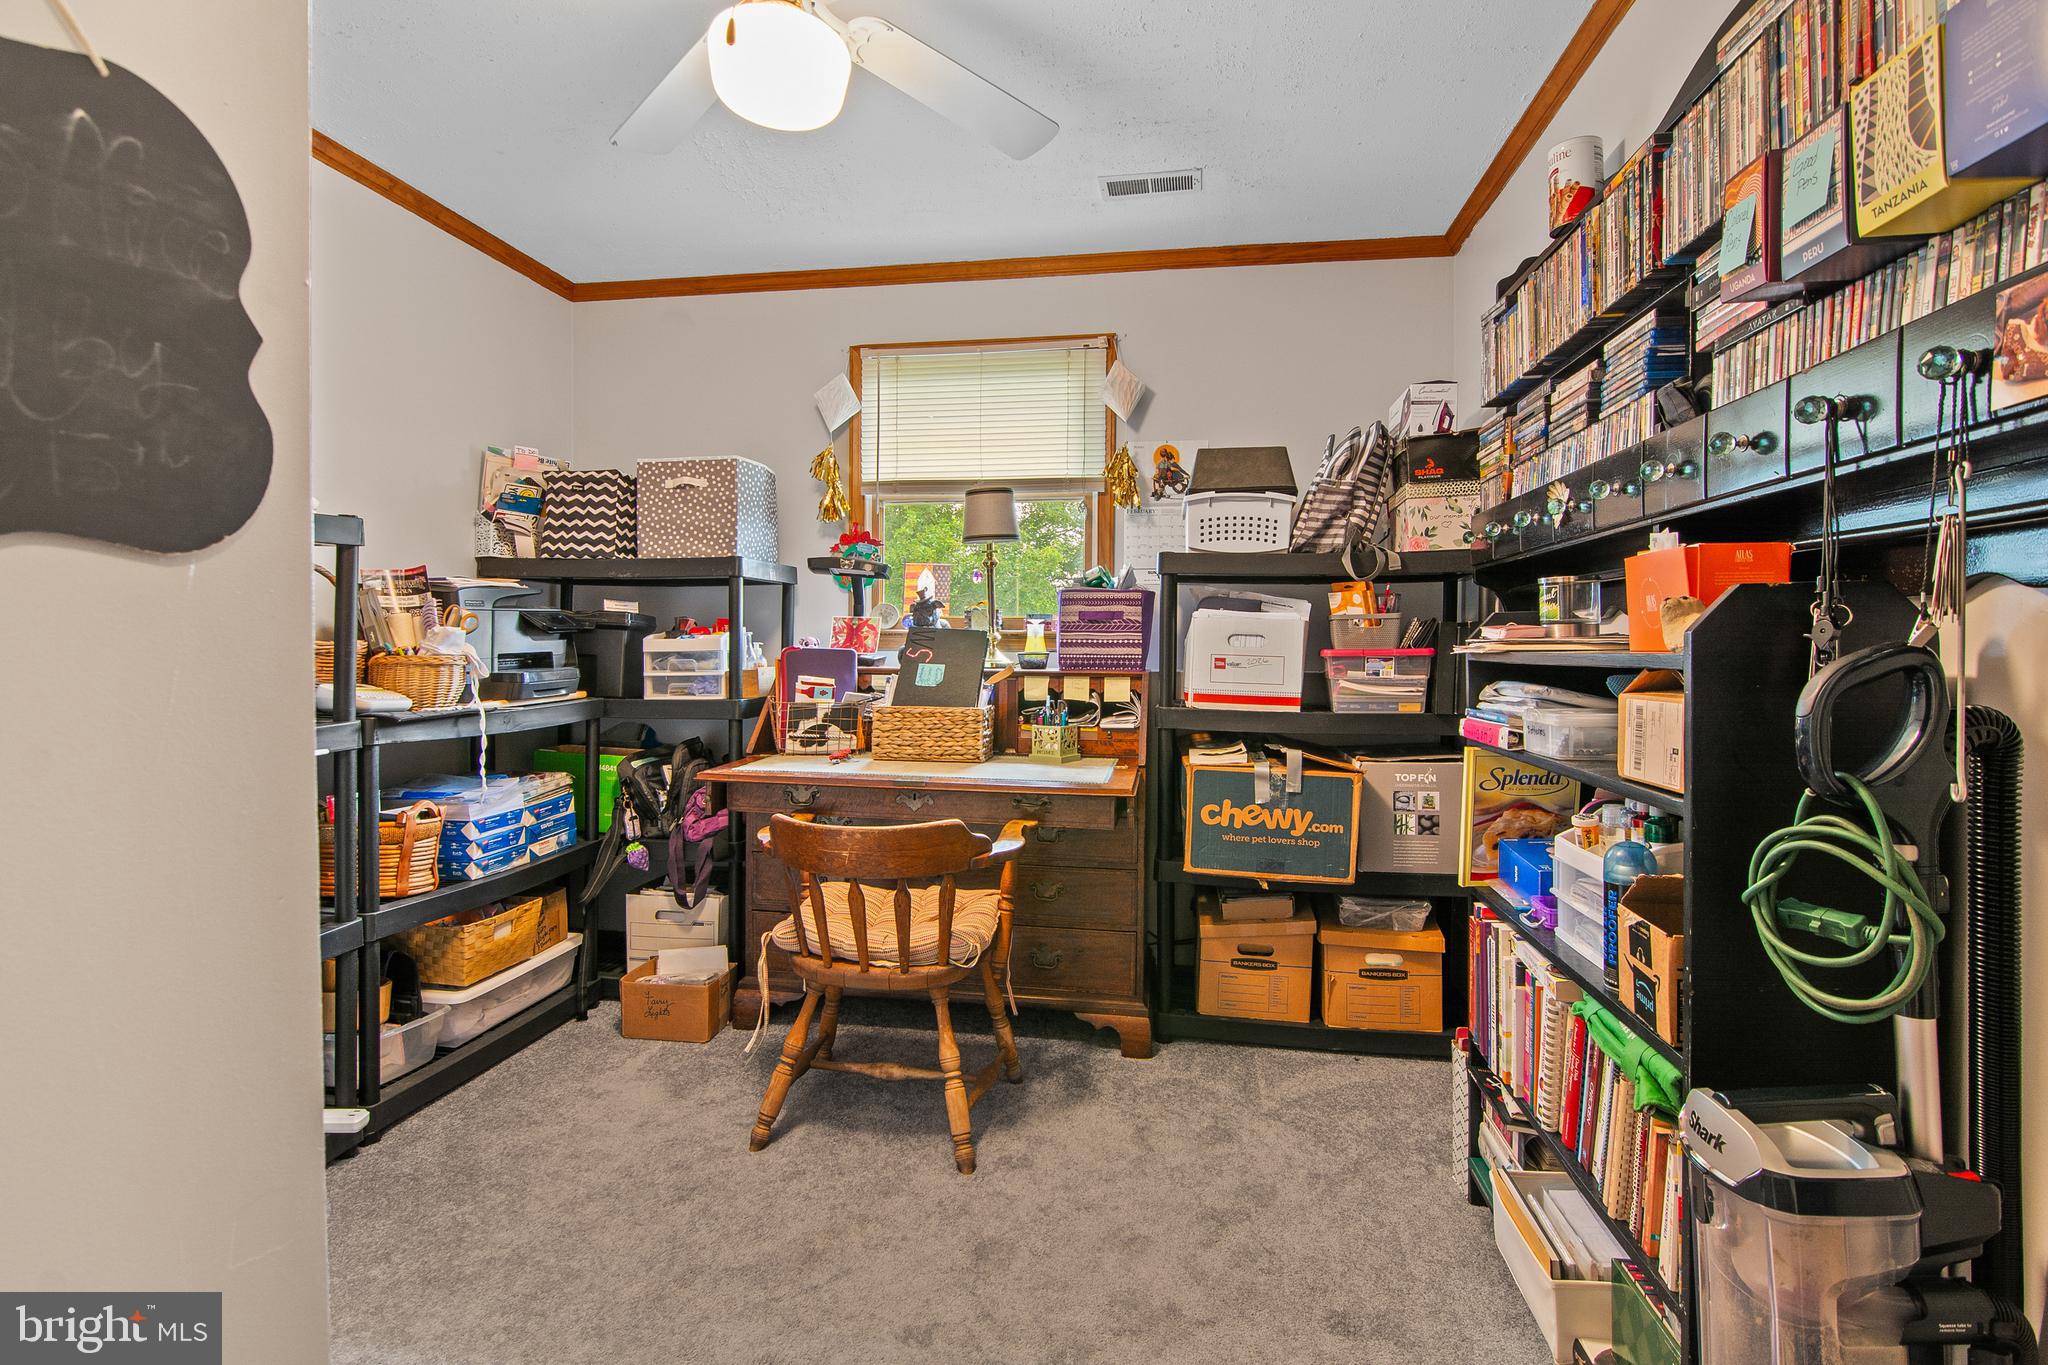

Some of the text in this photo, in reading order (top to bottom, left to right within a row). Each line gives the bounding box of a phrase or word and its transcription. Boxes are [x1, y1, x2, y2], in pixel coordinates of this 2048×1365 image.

[1792, 144, 1818, 178] Good
[1871, 179, 1929, 219] TANZANIA
[1802, 241, 1824, 263] PERU
[1729, 273, 1756, 293] UGANDA
[1747, 309, 1778, 331] AVATAR
[1414, 467, 1445, 476] SHAQ
[1735, 549, 1753, 559] ATLAS
[1395, 773, 1417, 782] TOP
[1479, 766, 1563, 790] Splenda
[1200, 799, 1344, 836] chewy.com
[1221, 832, 1321, 848] where pet lovers shop
[1608, 889, 1618, 967] PROOFER
[1360, 970, 1390, 978] BANKERS
[644, 990, 676, 1007] Fairy
[1635, 990, 1655, 1012] prime
[644, 1004, 671, 1020] Lights
[1586, 1081, 1595, 1126] CHICKEN
[1688, 1109, 1728, 1155] Shark
